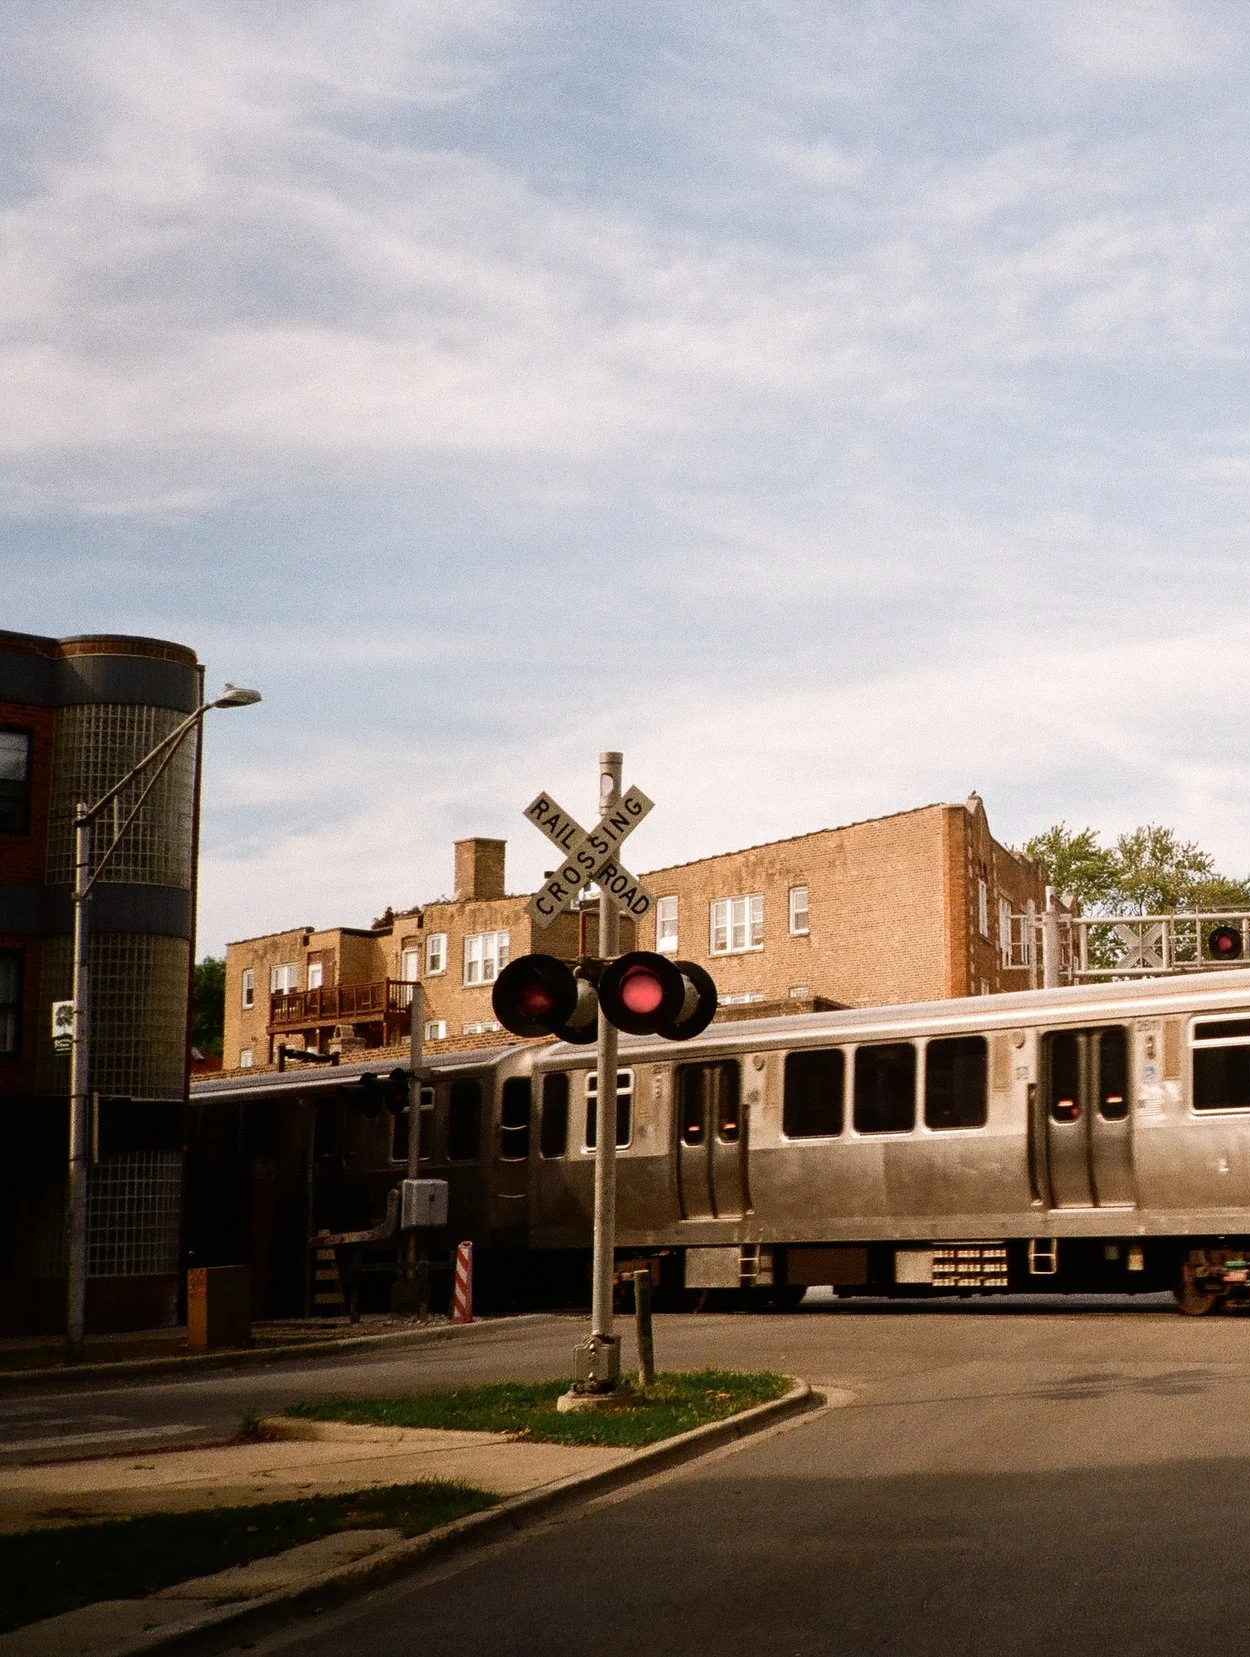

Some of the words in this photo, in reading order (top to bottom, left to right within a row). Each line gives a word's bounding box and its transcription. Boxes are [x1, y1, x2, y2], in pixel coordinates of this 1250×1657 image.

[530, 798, 576, 850] RAIL
[599, 863, 650, 915] ROAD
[535, 797, 643, 915] CROSSING
